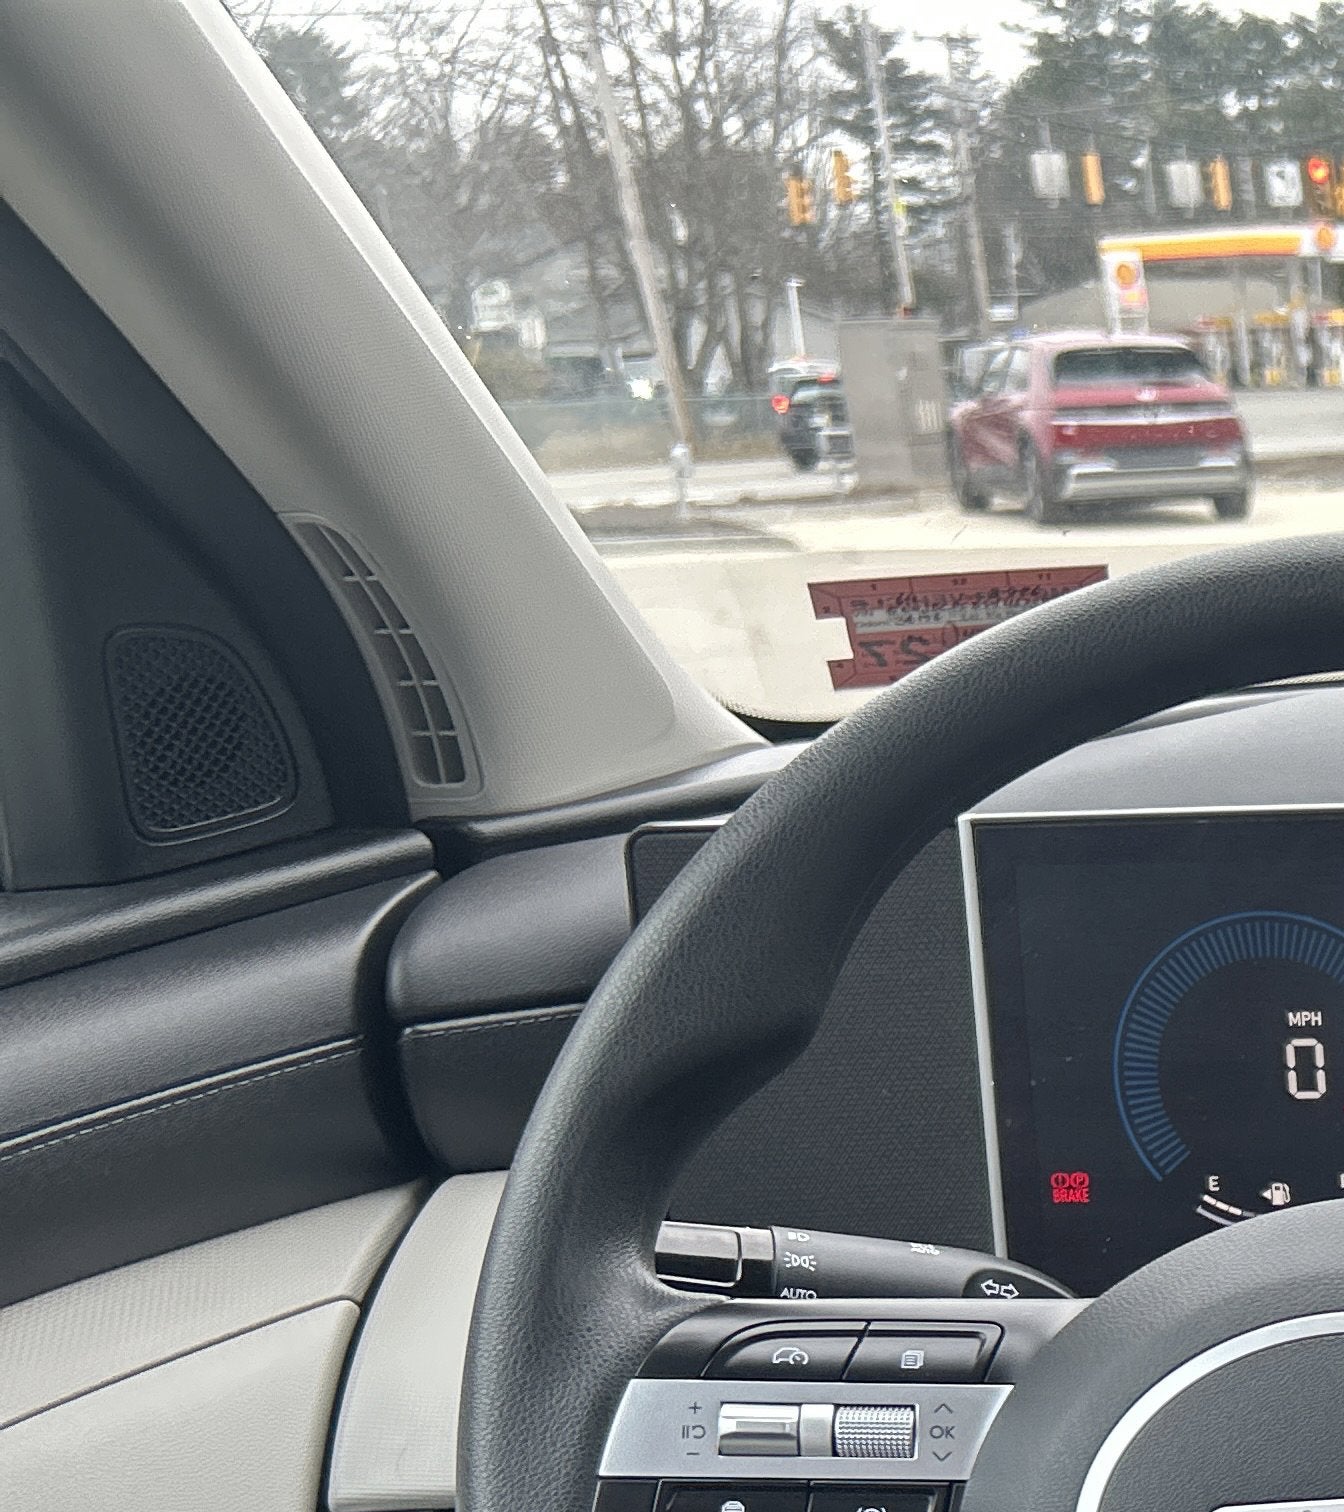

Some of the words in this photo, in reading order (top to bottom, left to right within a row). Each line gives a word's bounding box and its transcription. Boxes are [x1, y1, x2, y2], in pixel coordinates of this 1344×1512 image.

[1287, 1011, 1323, 1028] MPH
[1285, 1037, 1327, 1100] 0
[1207, 1175, 1220, 1192] E
[1052, 1188, 1089, 1203] BRAKE
[780, 1287, 817, 1300] AUTO
[929, 1424, 956, 1442] OK
